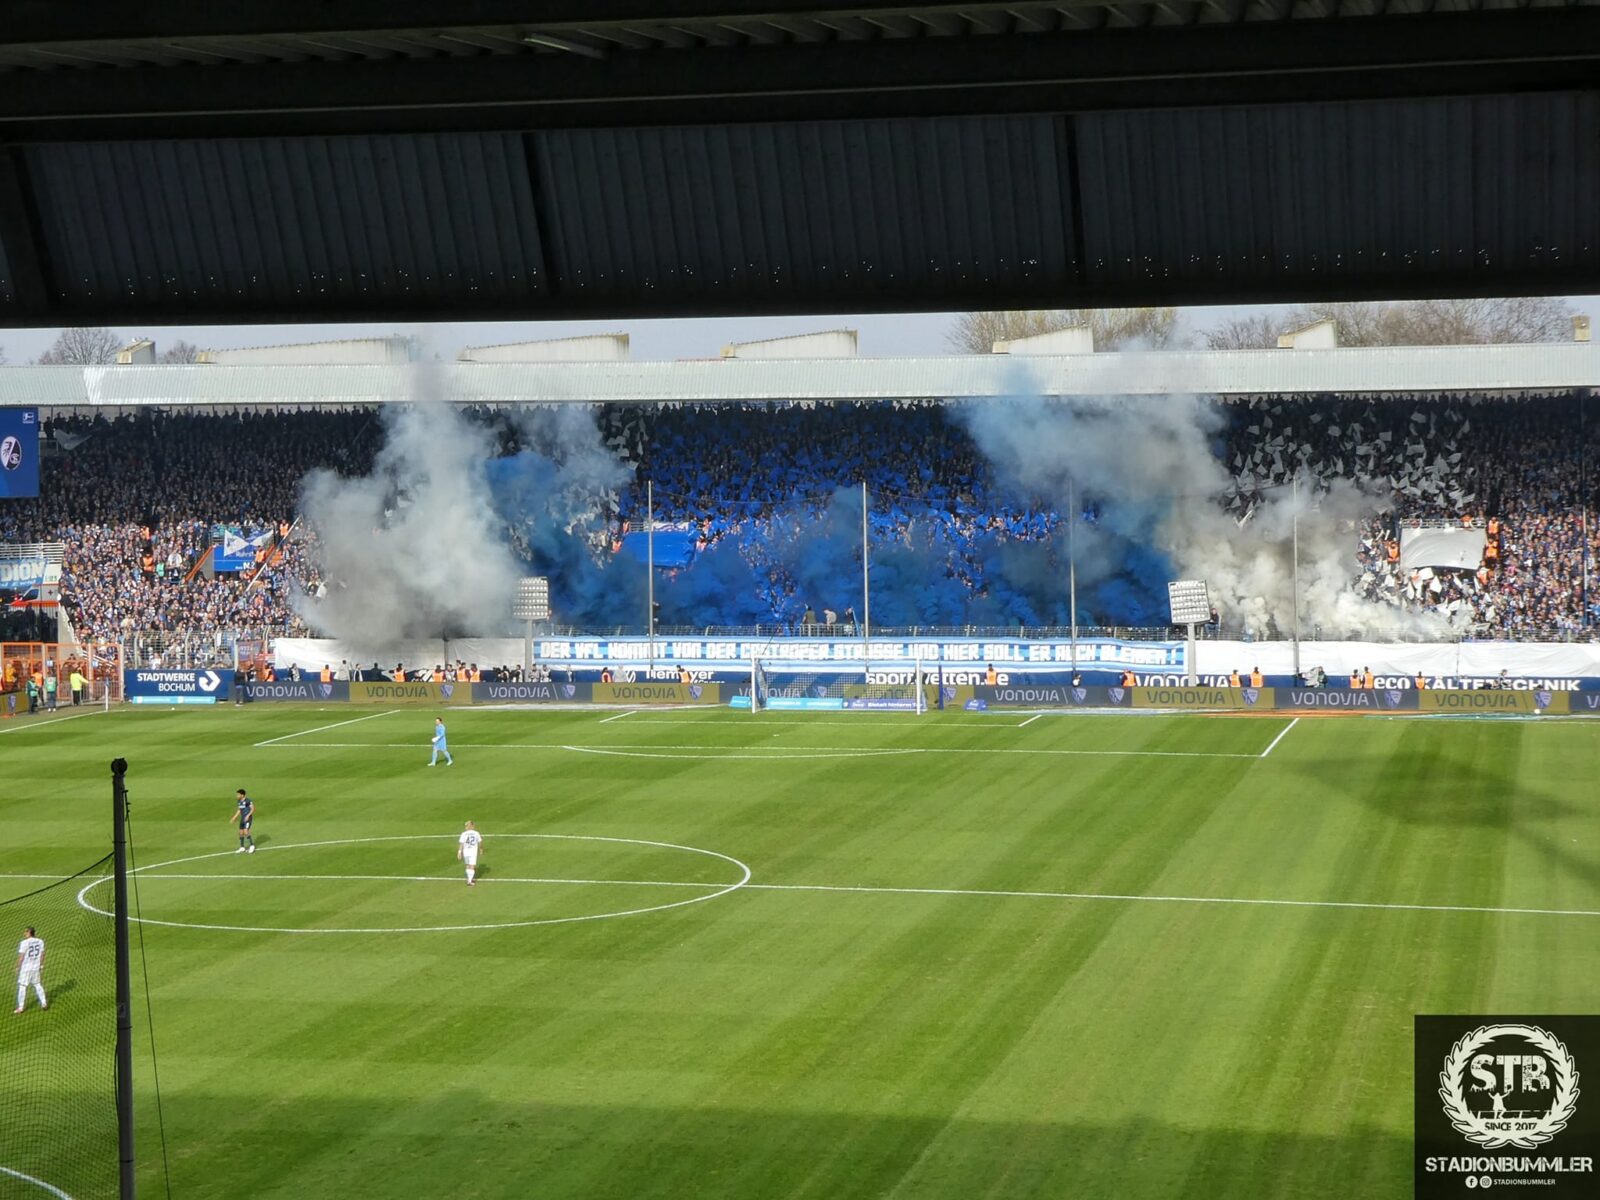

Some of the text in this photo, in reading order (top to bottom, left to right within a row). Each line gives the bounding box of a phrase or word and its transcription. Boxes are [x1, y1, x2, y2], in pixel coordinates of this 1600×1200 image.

[540, 642, 571, 658] DER
[575, 642, 603, 658] VFL
[672, 642, 702, 659] VON
[706, 642, 737, 660] DER
[908, 644, 939, 660] UND
[943, 644, 980, 661] HIER
[984, 644, 1025, 661] SOLL
[1029, 645, 1051, 662] ER
[137, 672, 195, 682] STADTWERKE
[1373, 677, 1411, 689] eco
[158, 682, 196, 692] BOCHUM
[247, 686, 308, 697] VONOVIA
[366, 686, 428, 698] VONOVIA
[488, 686, 551, 698] VONOVIA
[612, 687, 676, 699] VONOVIA
[994, 689, 1060, 701] VONOVIA
[1146, 690, 1226, 704] VONOVIA
[1291, 691, 1369, 705] VONOVIA
[1434, 693, 1518, 707] VONOVIA
[465, 836, 476, 846] 42
[28, 944, 40, 957] 25
